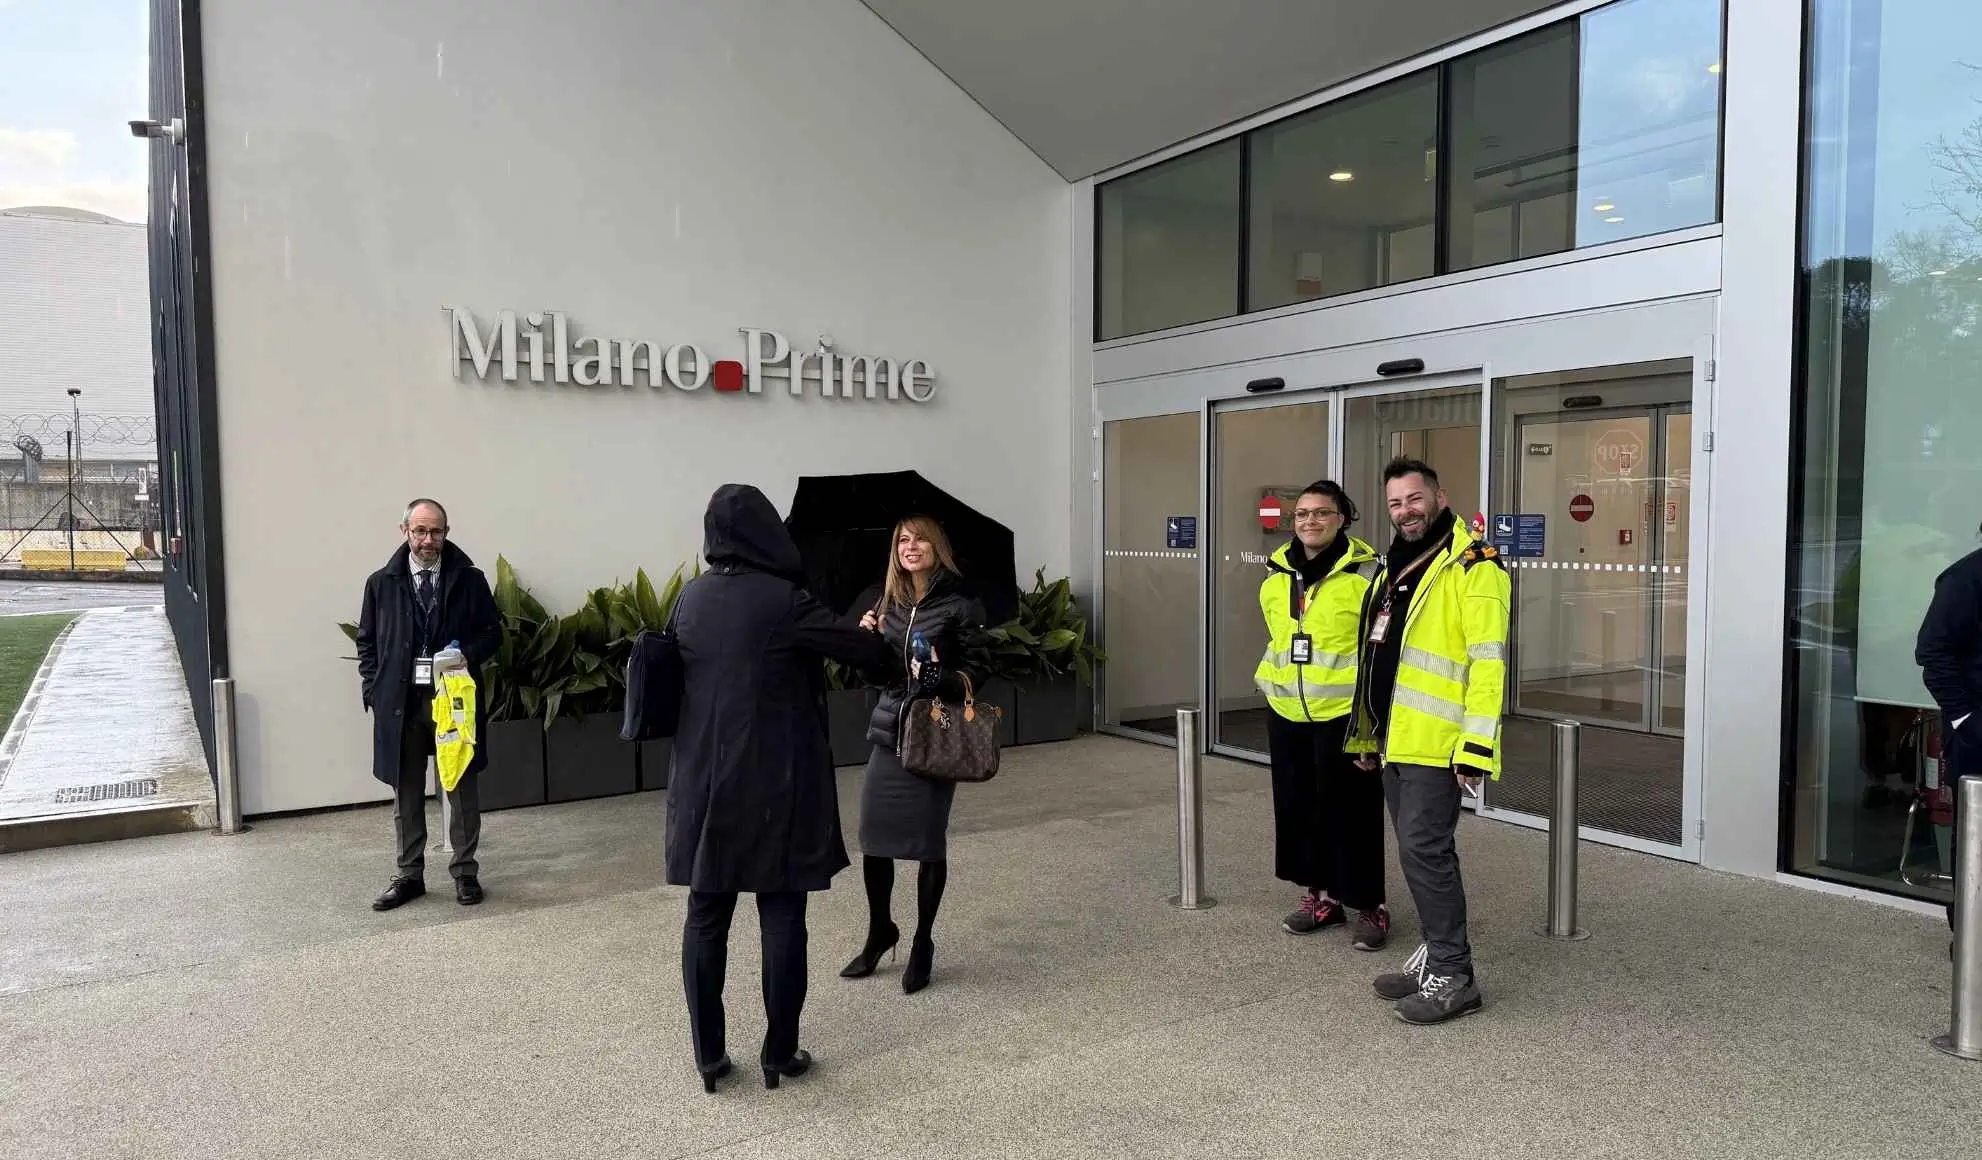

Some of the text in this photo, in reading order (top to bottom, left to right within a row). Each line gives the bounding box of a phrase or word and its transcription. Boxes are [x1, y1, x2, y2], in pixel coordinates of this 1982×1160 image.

[439, 304, 937, 402] Milano Prime
[1240, 551, 1268, 564] Milano
